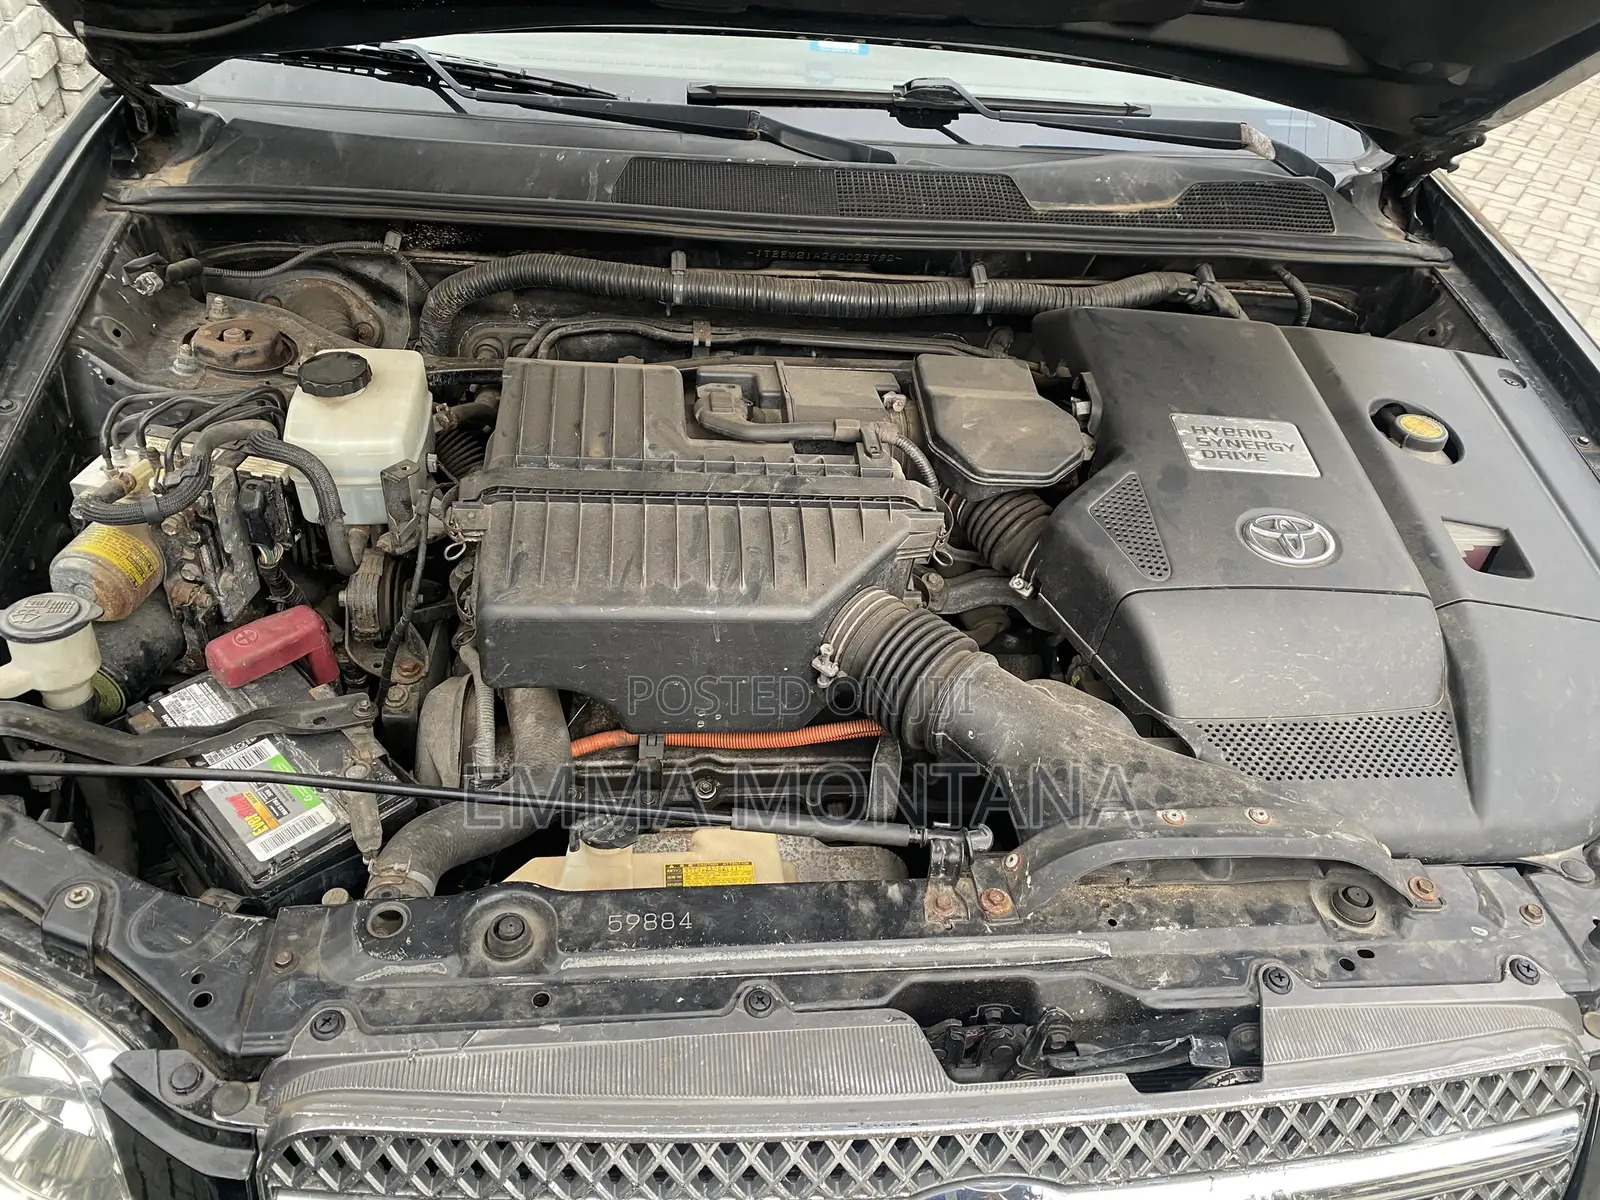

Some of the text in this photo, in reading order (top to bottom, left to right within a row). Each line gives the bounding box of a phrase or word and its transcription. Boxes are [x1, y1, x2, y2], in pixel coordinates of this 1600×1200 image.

[1190, 425, 1273, 440] HYBRID
[1195, 437, 1296, 452] SYNERGY
[1201, 449, 1269, 463] DRIVE
[607, 911, 693, 933] 59884
